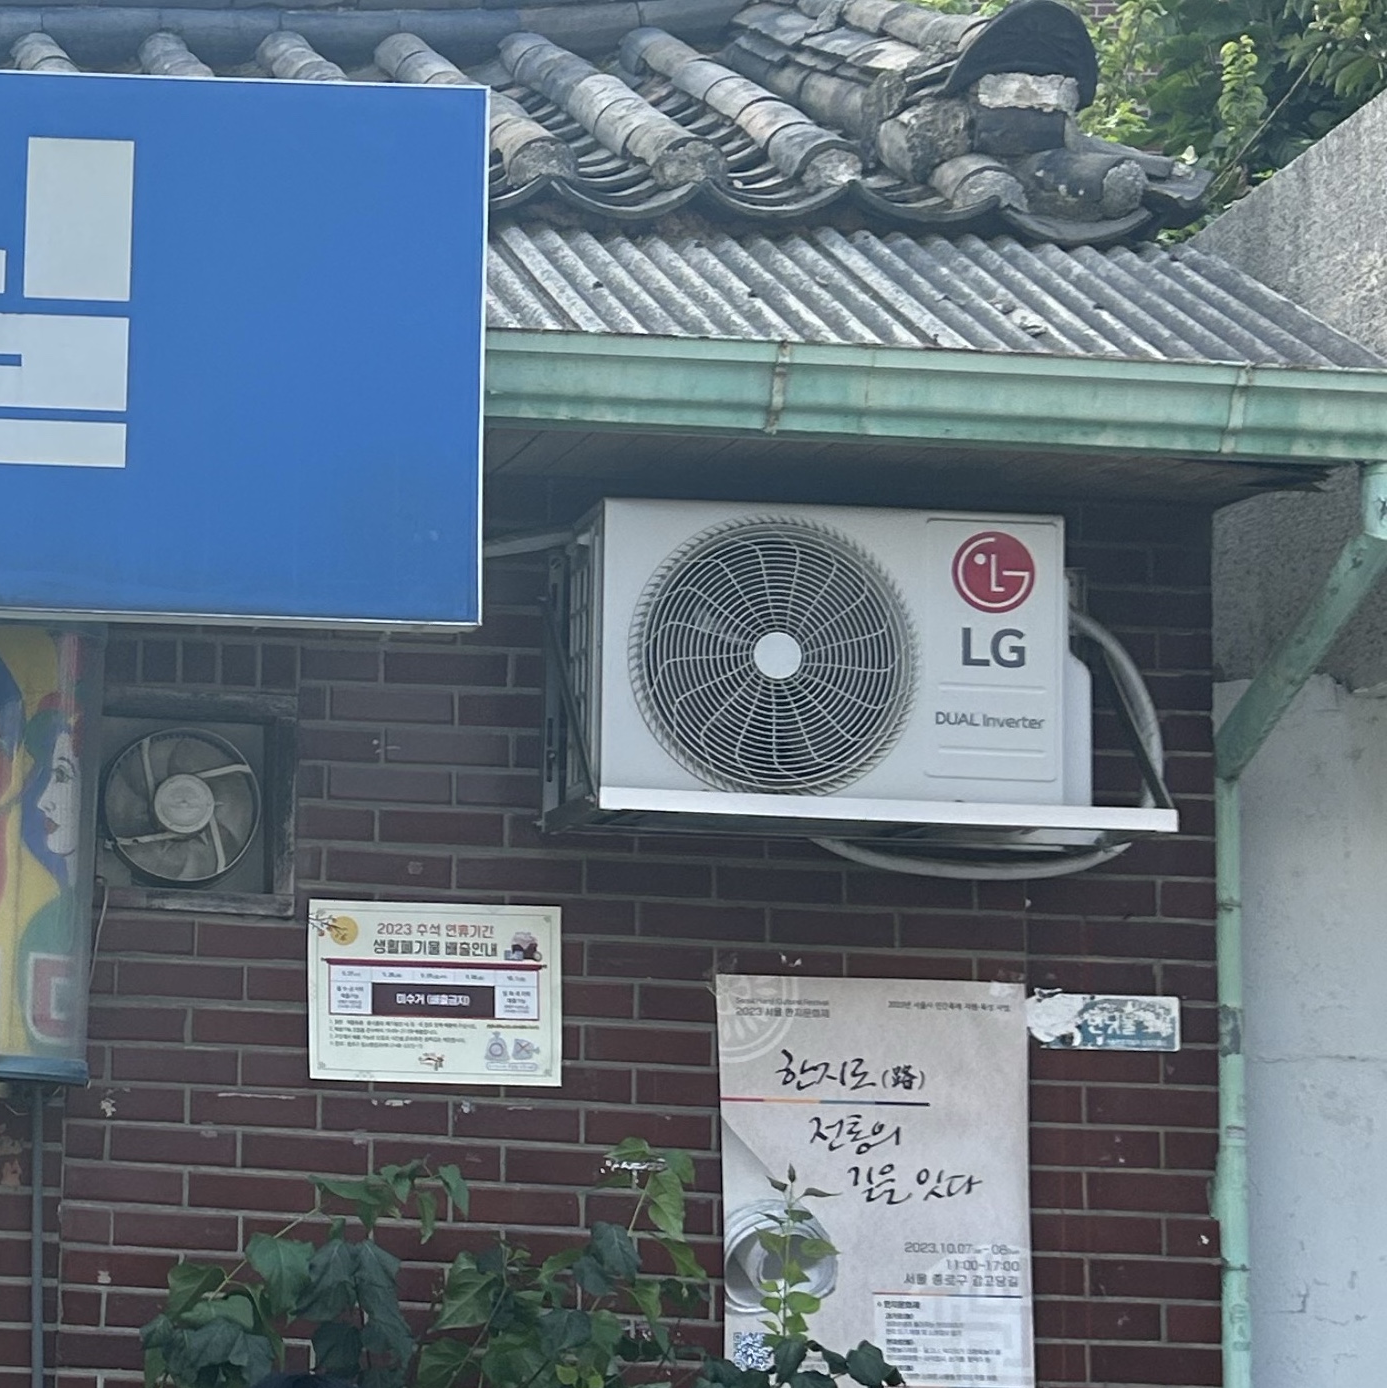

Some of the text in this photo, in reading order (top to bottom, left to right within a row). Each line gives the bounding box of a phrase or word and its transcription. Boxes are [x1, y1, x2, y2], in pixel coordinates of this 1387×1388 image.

[961, 627, 1026, 668] LG
[935, 711, 1046, 730] DUAL Inverter
[377, 922, 494, 939] 2023 추석 연휴기간
[373, 939, 497, 958] 생활폐기물 배출안내
[395, 993, 426, 1006] 미수거
[735, 1007, 762, 1016] 2023
[809, 1114, 901, 1155] 전통의
[847, 1164, 913, 1205] 길을
[904, 1273, 927, 1285] 서울
[932, 1273, 968, 1286] 종로구
